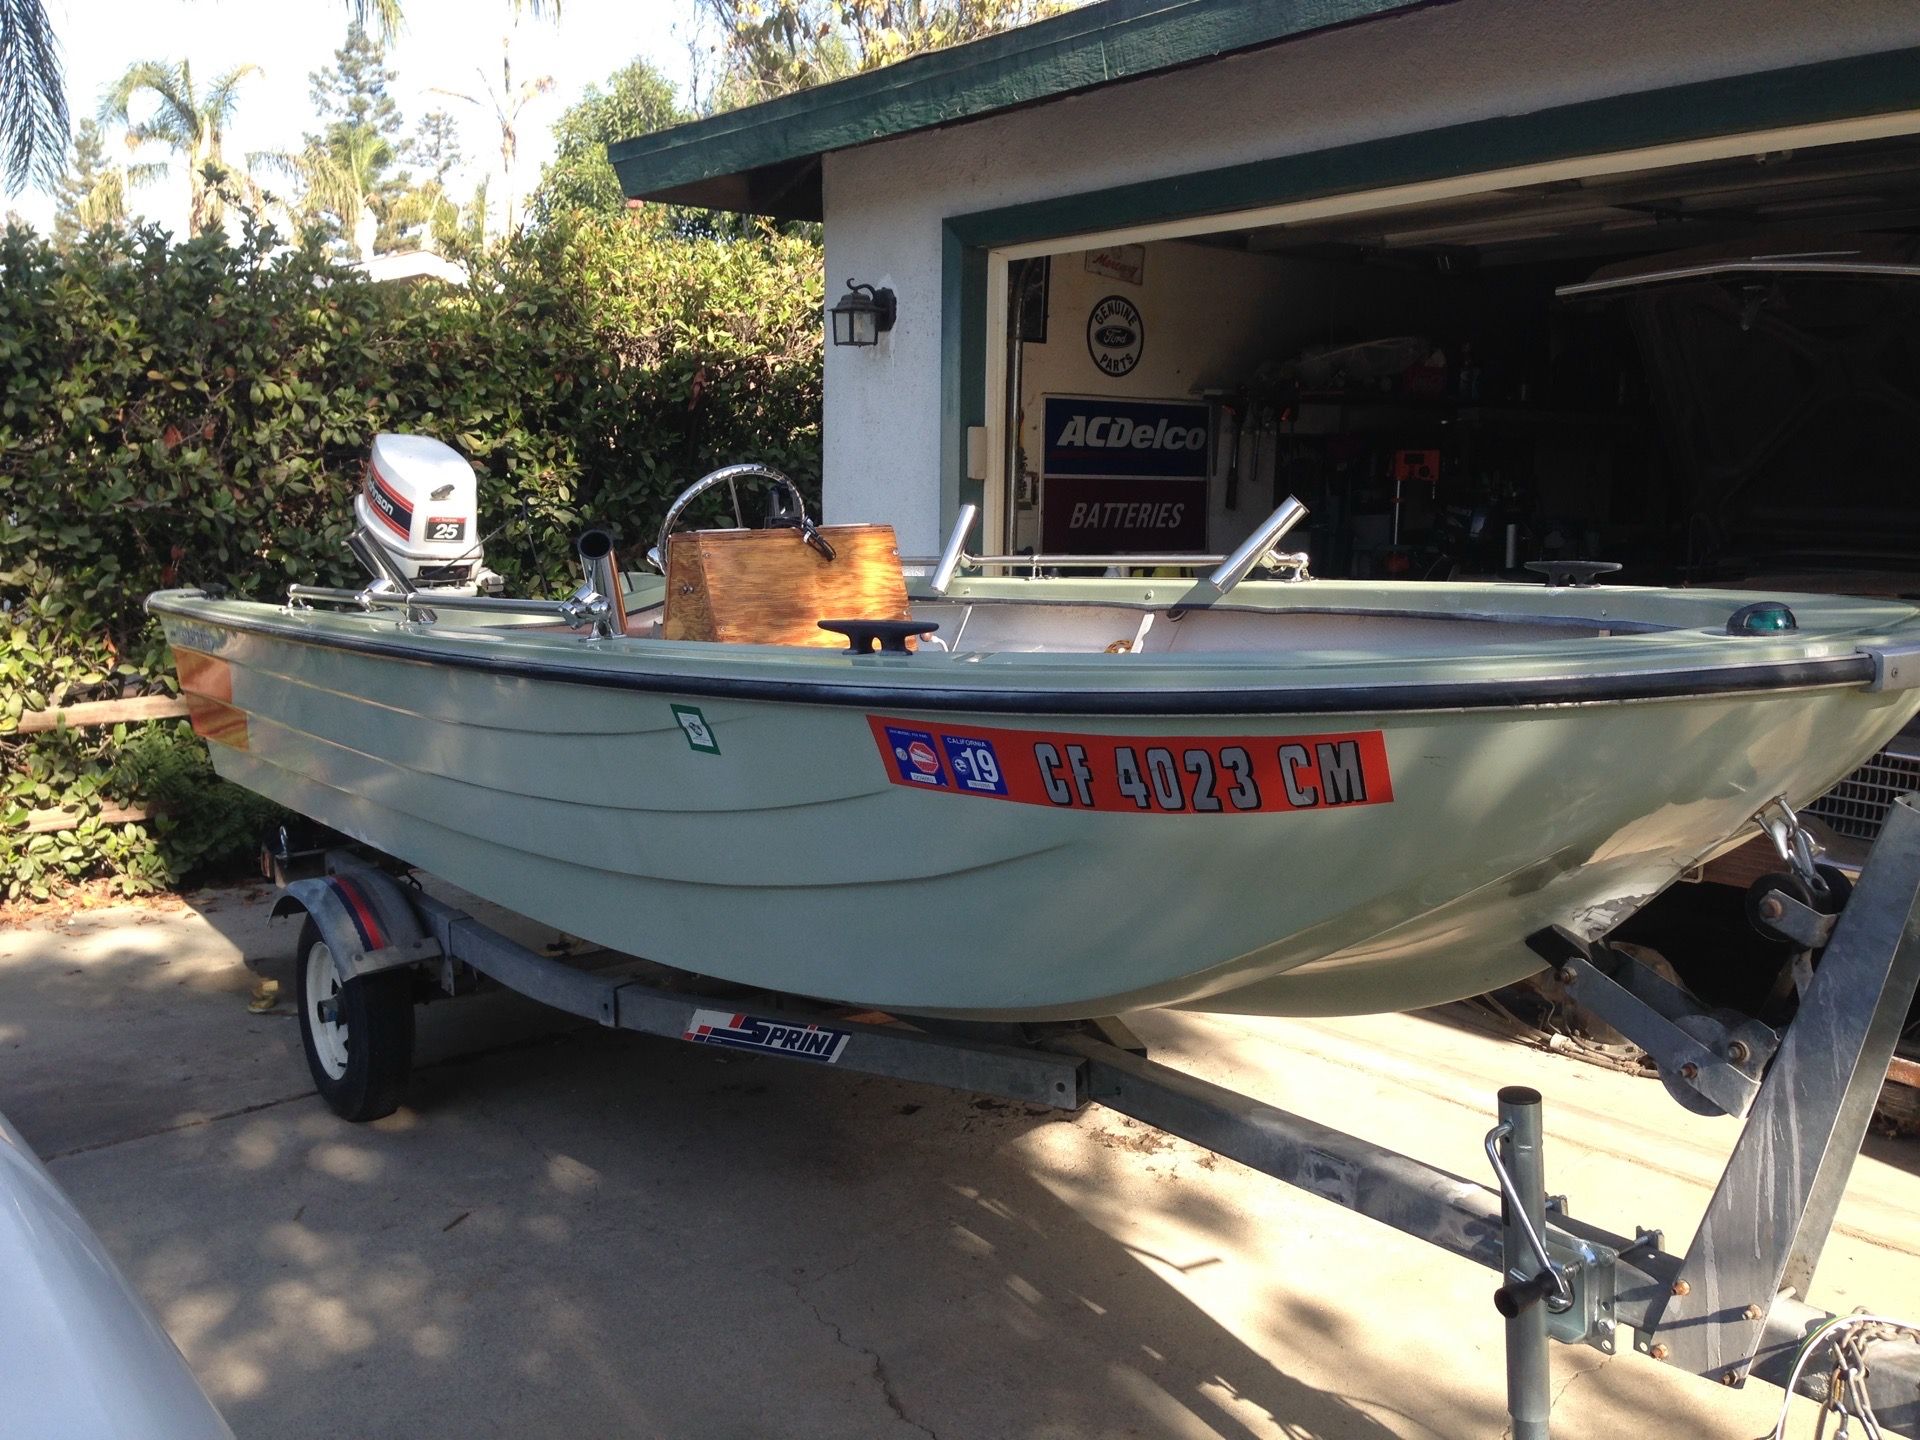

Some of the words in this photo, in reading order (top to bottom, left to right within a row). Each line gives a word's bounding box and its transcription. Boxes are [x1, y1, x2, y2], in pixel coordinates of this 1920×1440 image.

[1094, 299, 1137, 327] GENUINE
[1103, 329, 1128, 345] Ford
[1100, 353, 1134, 372] PARTS
[1056, 415, 1207, 451] ACDelco
[1069, 502, 1185, 529] BATTERIES
[433, 523, 459, 540] 25
[946, 737, 987, 748] CALIFORNIA
[960, 747, 999, 783] 19
[1034, 742, 1095, 807] CF
[1114, 746, 1262, 812] 4023
[1277, 740, 1369, 807] CM
[738, 1015, 852, 1056] SPRINT
